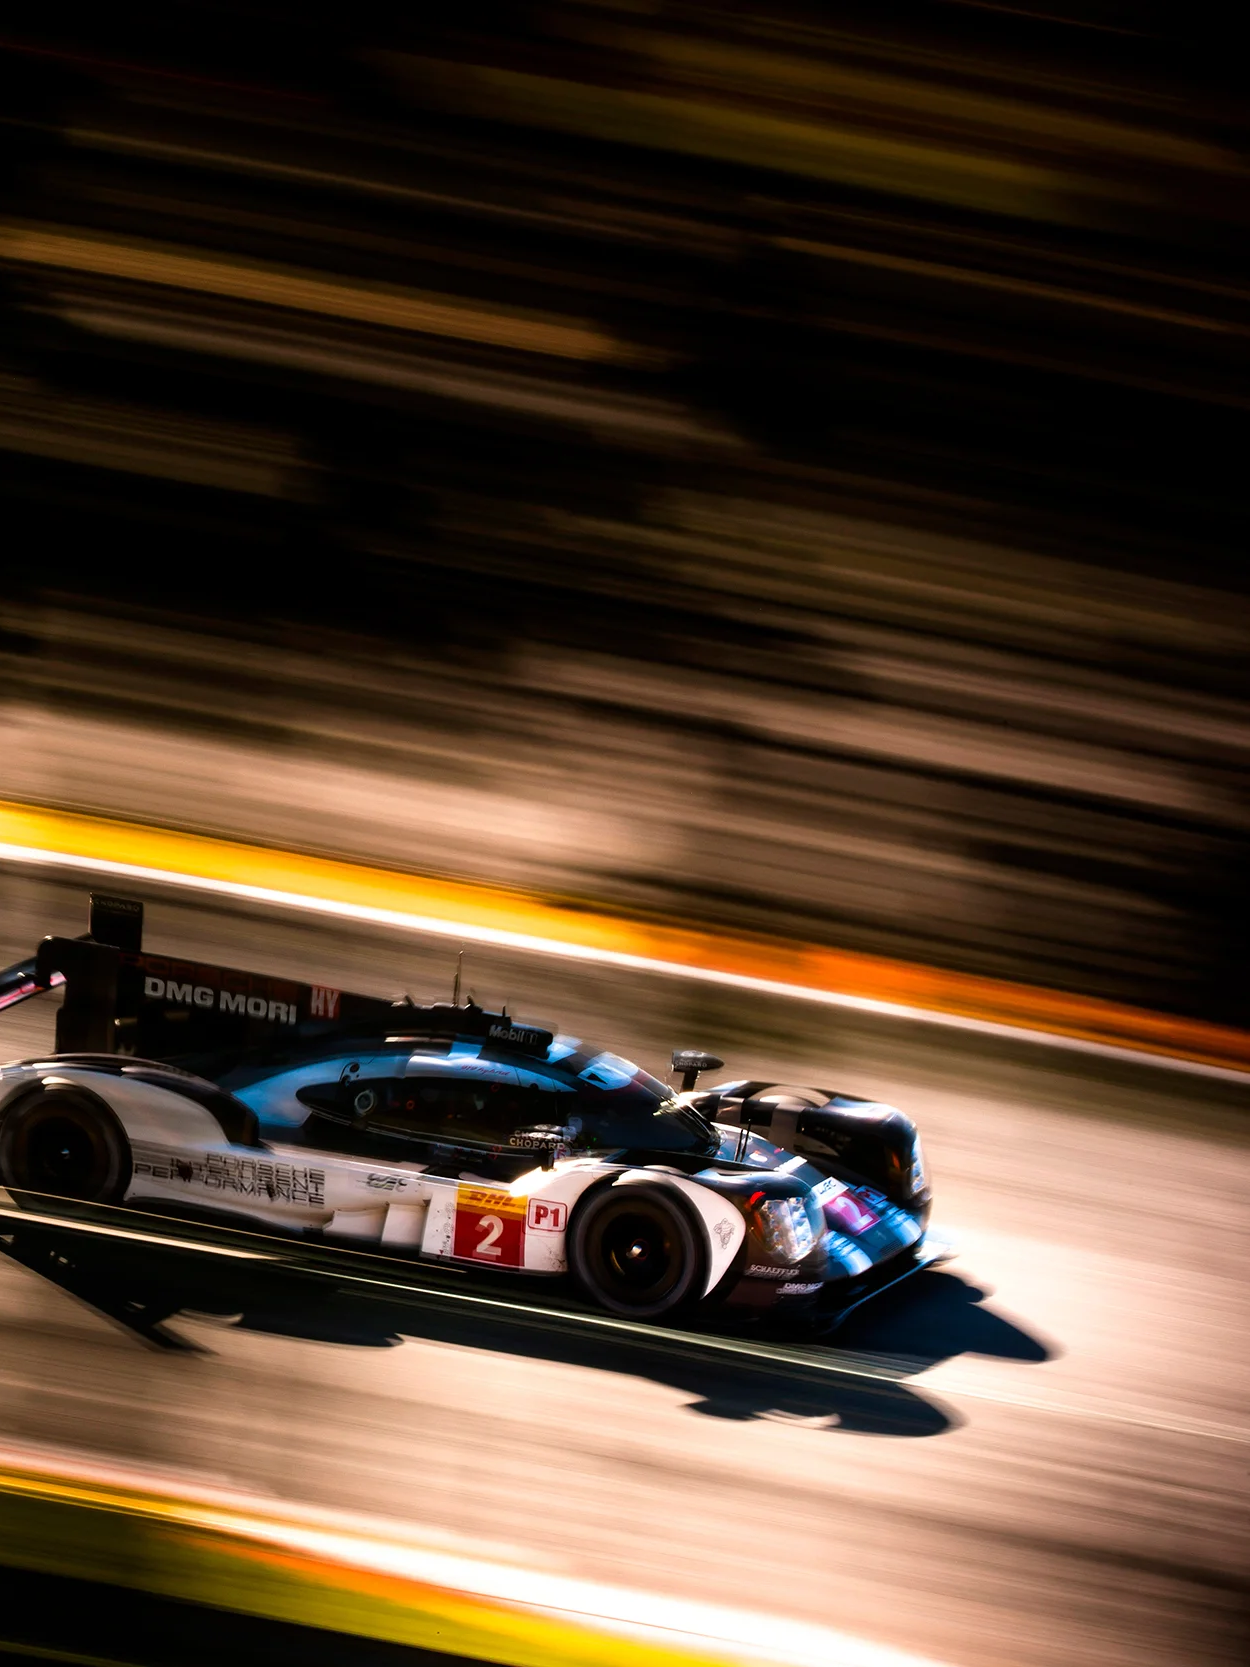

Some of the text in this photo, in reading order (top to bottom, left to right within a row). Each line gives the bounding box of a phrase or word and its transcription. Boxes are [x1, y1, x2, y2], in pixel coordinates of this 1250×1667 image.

[144, 976, 297, 1025] DMG MORI
[310, 986, 339, 1019] HY
[489, 1024, 525, 1043] Mobil
[510, 1137, 565, 1150] CHOPARD
[467, 1190, 518, 1208] DHL
[534, 1204, 560, 1228] P1
[835, 1196, 874, 1231] 2
[474, 1214, 504, 1258] 2
